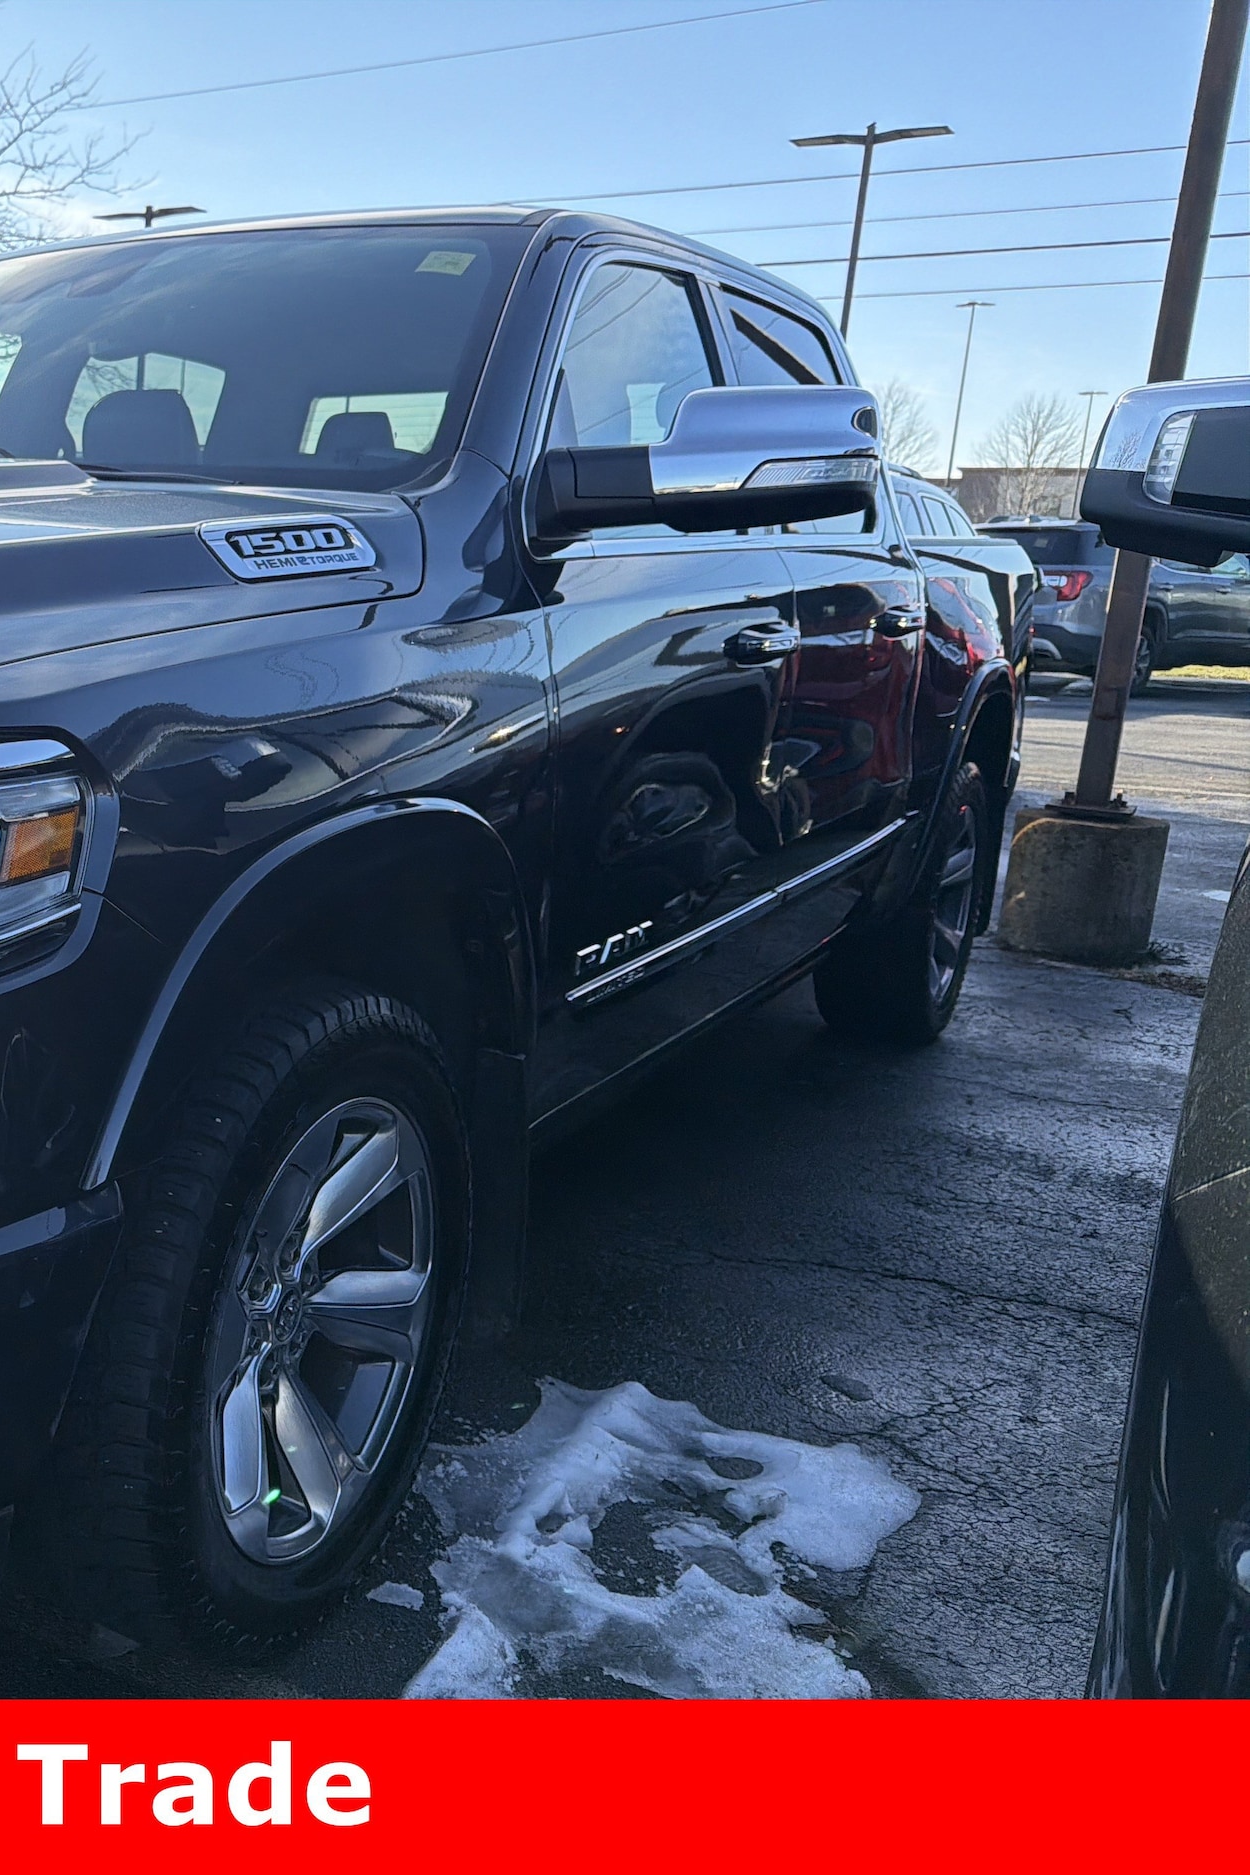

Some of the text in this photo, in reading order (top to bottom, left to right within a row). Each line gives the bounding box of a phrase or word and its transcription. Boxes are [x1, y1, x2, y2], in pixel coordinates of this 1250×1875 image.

[232, 528, 345, 556] 1500
[253, 556, 298, 570] HEMI
[574, 920, 653, 976] RAM
